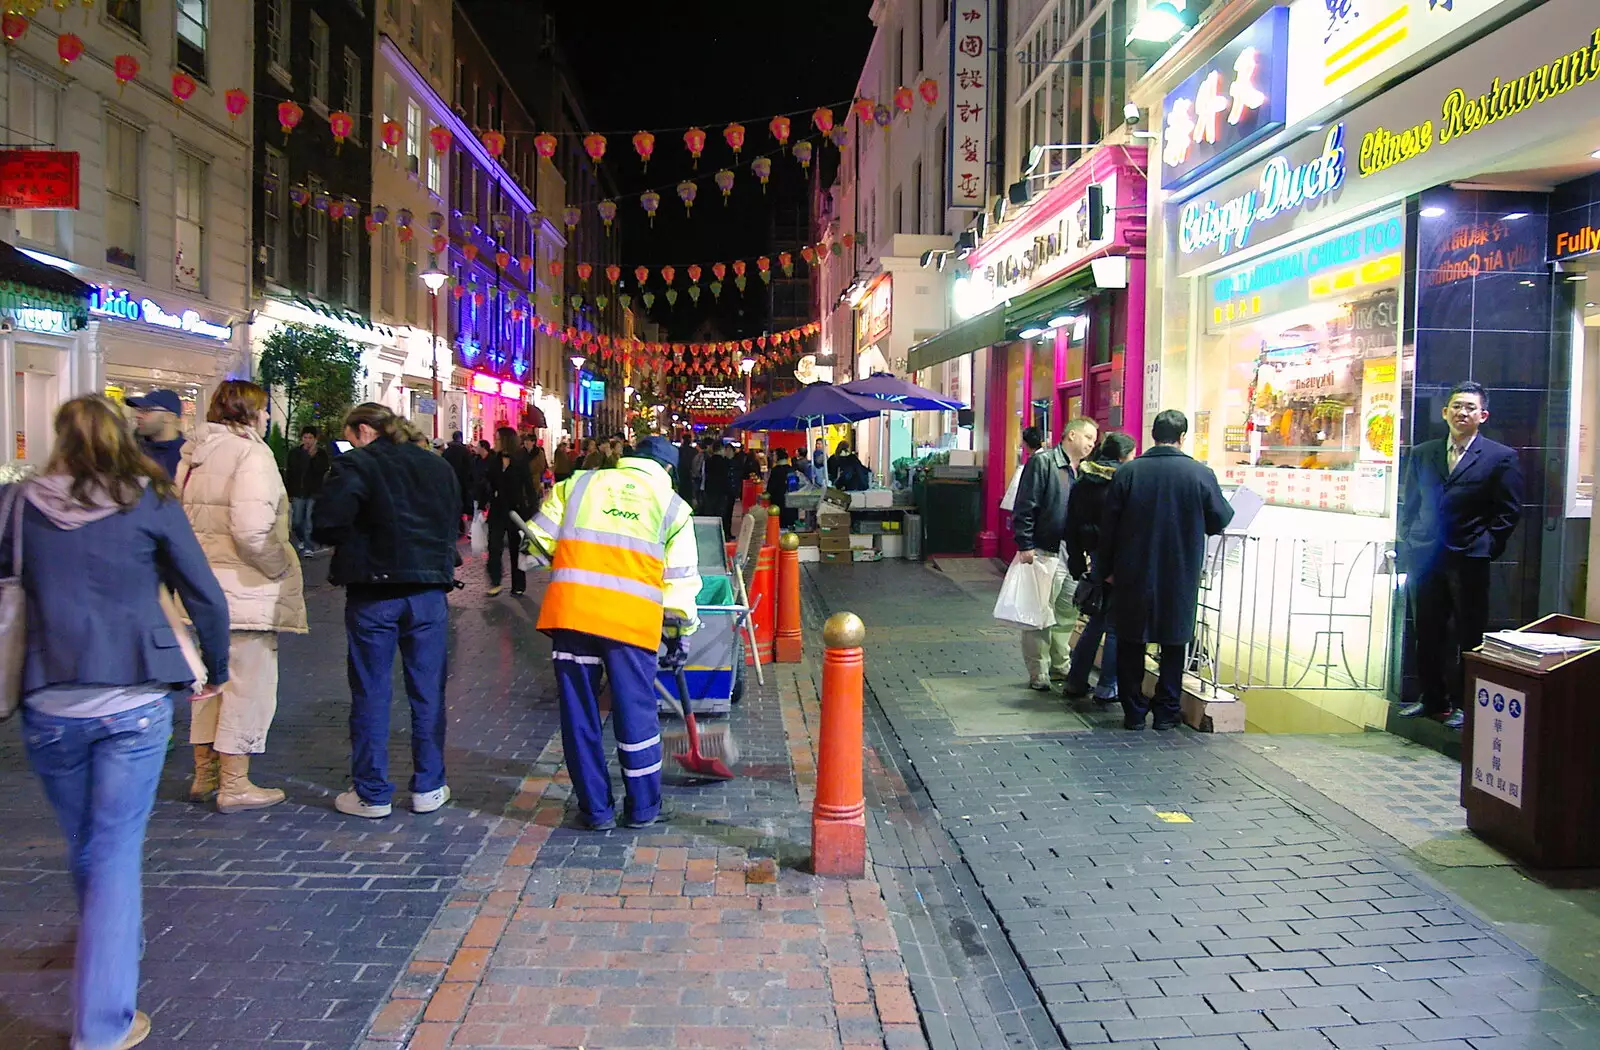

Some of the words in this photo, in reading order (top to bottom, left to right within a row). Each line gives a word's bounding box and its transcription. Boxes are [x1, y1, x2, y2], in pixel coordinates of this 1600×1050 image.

[1359, 120, 1433, 179] Chinese
[1439, 28, 1600, 145] Restaurant
[1178, 190, 1257, 255] Crispy
[1256, 122, 1346, 222] Duck
[1308, 232, 1362, 273] CHINESE
[1556, 226, 1600, 256] Fully
[90, 285, 138, 320] Lido
[607, 508, 640, 521] ONYX
